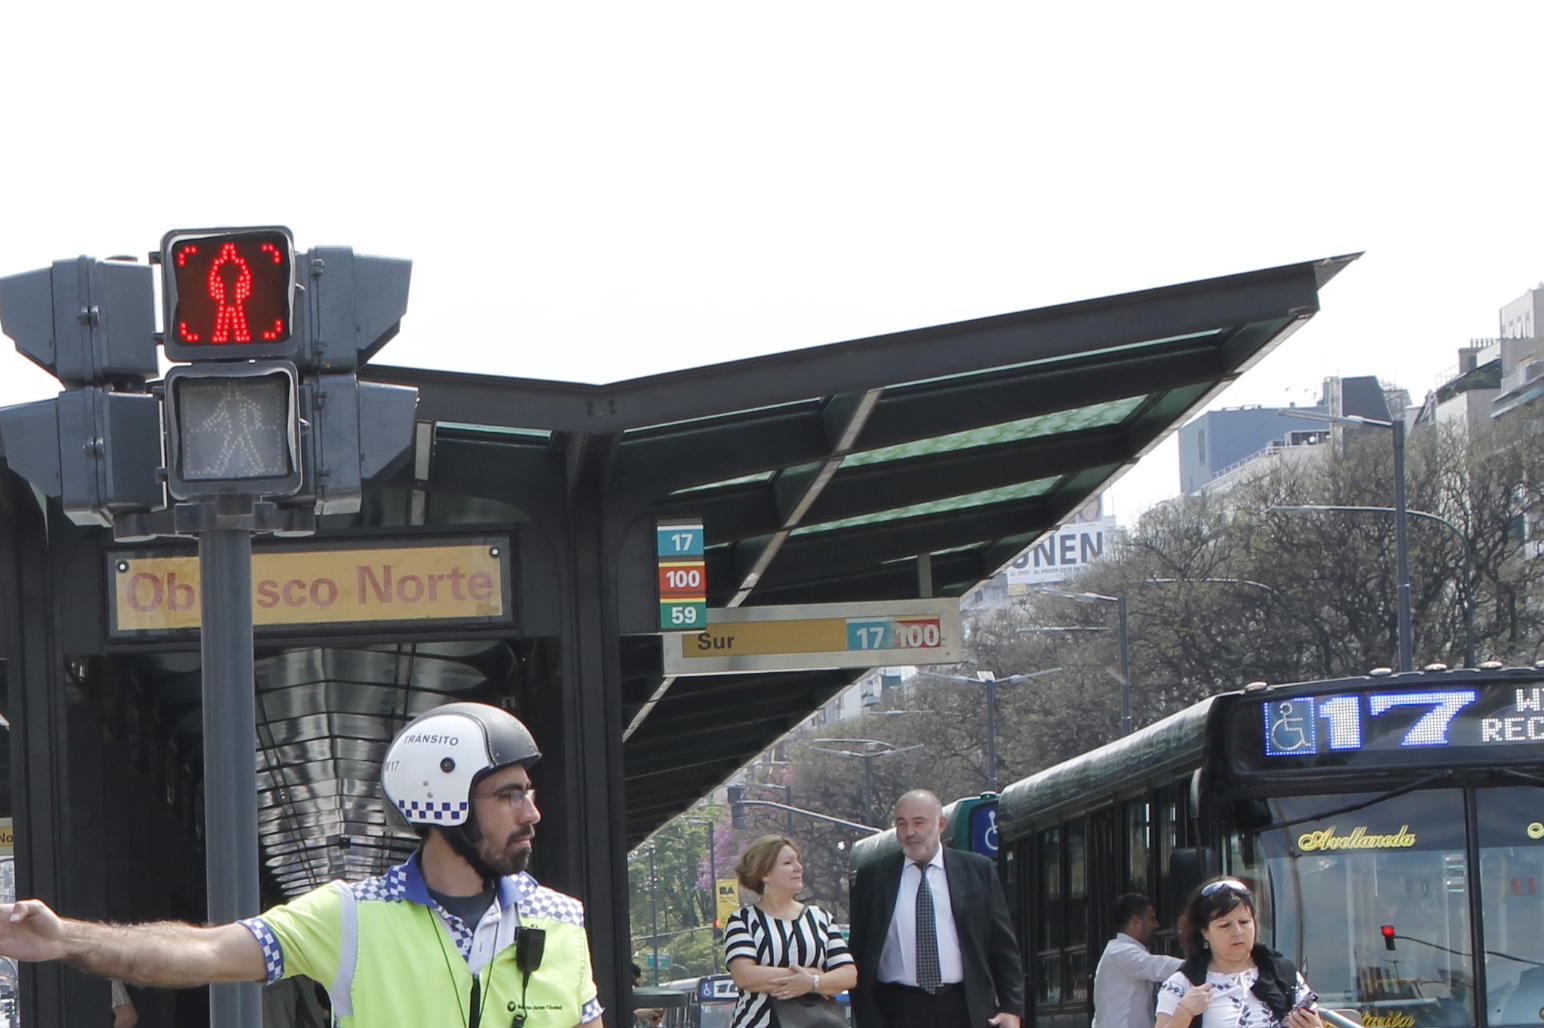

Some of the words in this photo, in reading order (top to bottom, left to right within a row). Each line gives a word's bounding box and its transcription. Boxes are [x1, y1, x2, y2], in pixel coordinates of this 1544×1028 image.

[671, 533, 694, 551] 17
[126, 572, 339, 613] Obsco
[357, 564, 494, 604] Norte
[666, 569, 701, 588] 100
[671, 606, 697, 624] 59
[697, 632, 735, 650] Sur
[856, 627, 885, 649] 17
[895, 623, 940, 648] 100
[1318, 690, 1477, 750] 17
[1516, 688, 1544, 712] W
[1297, 823, 1417, 852] Avellaneda
